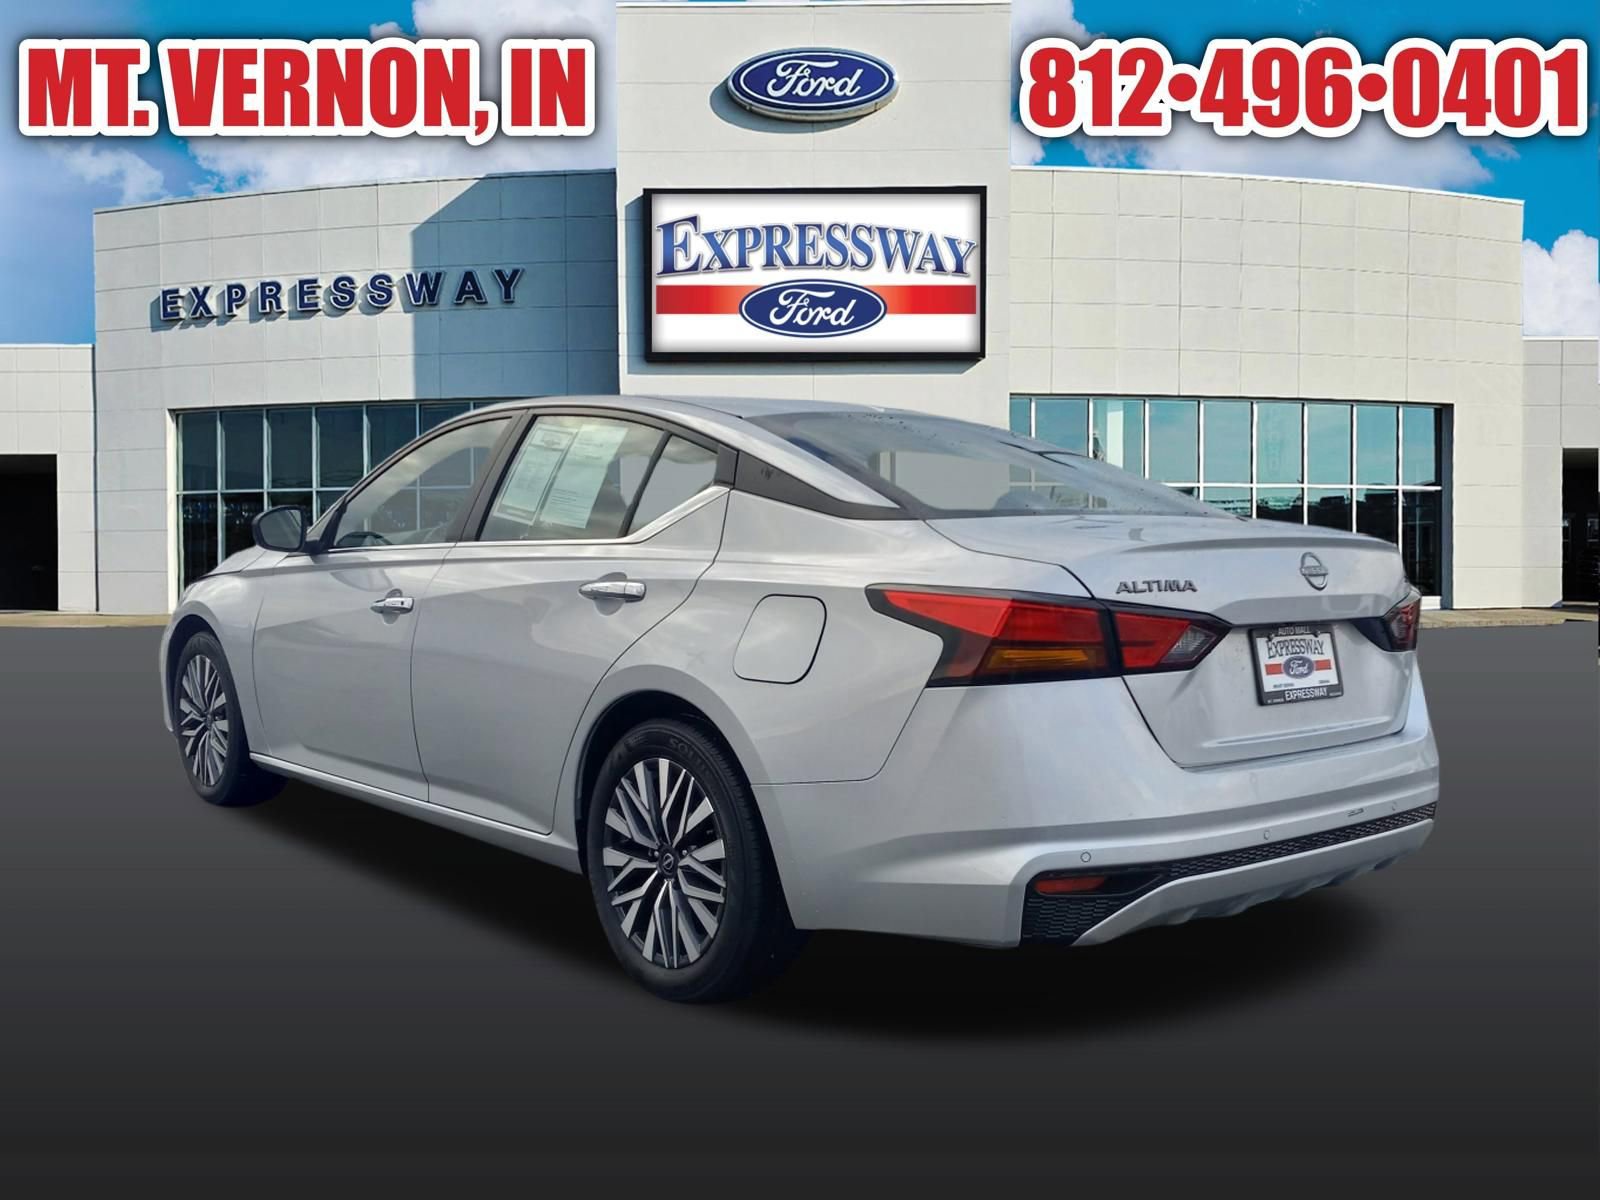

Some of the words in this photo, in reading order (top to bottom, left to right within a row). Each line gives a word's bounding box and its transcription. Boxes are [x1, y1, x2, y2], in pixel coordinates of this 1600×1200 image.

[767, 59, 864, 98] Ford
[655, 213, 978, 278] EXPRESSWAY
[159, 267, 526, 322] EXPRESSWAY
[768, 287, 858, 327] Ford
[1116, 579, 1198, 595] ALTIMA
[1266, 638, 1325, 659] EXPRESSWAY
[1289, 660, 1309, 674] Ford
[1285, 687, 1329, 701] EXPRESSWAY
